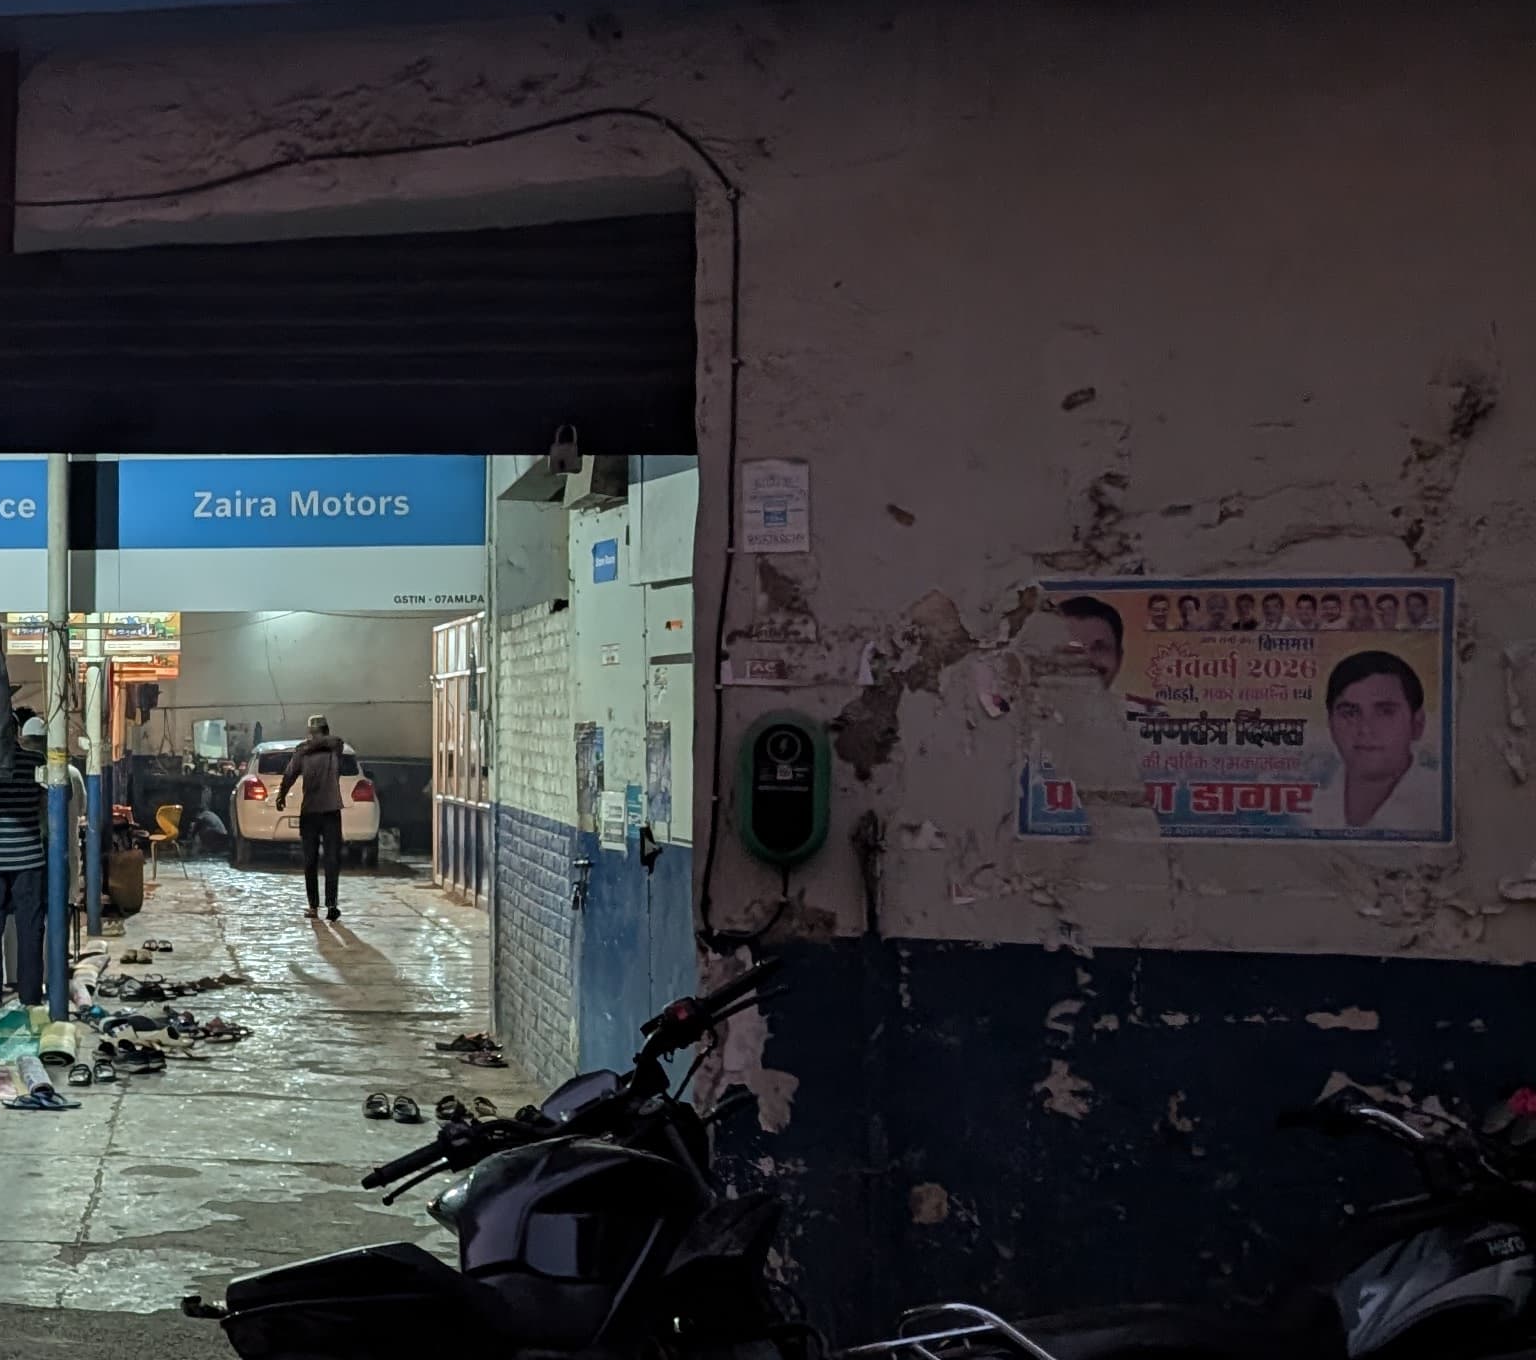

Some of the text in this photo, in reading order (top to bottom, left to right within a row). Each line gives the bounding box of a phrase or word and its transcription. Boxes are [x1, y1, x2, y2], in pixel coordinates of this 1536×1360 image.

[194, 489, 410, 519] Zaira Motors
[393, 595, 426, 605] GSTIN
[1247, 658, 1317, 679] 2026
